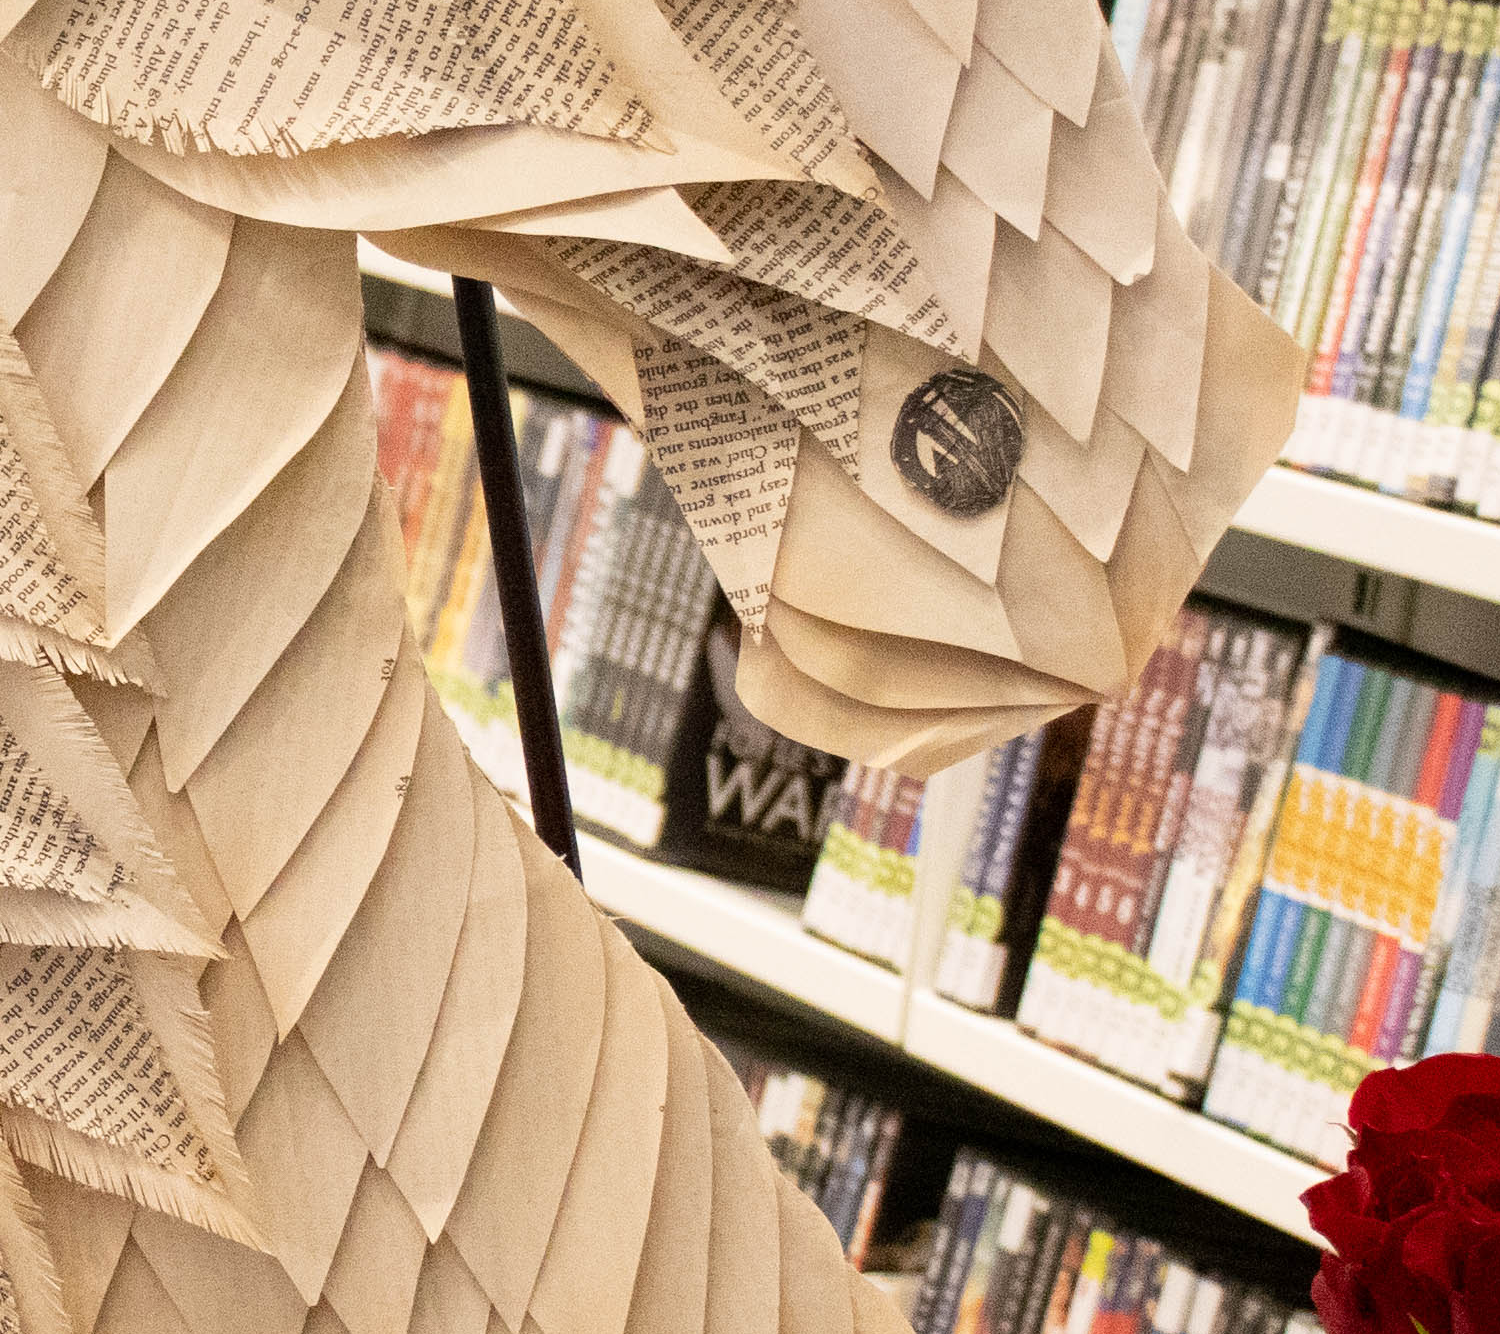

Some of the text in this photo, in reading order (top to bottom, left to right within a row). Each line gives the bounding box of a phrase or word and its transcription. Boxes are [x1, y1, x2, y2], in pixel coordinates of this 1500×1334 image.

[208, 1, 232, 34] claw
[82, 53, 118, 110] plunged
[296, 31, 346, 108] How many
[674, 410, 747, 437] Fangburn
[688, 421, 778, 452] malcontents
[725, 445, 767, 462] Chief
[690, 461, 765, 492] persuasive
[724, 478, 789, 506] easy task
